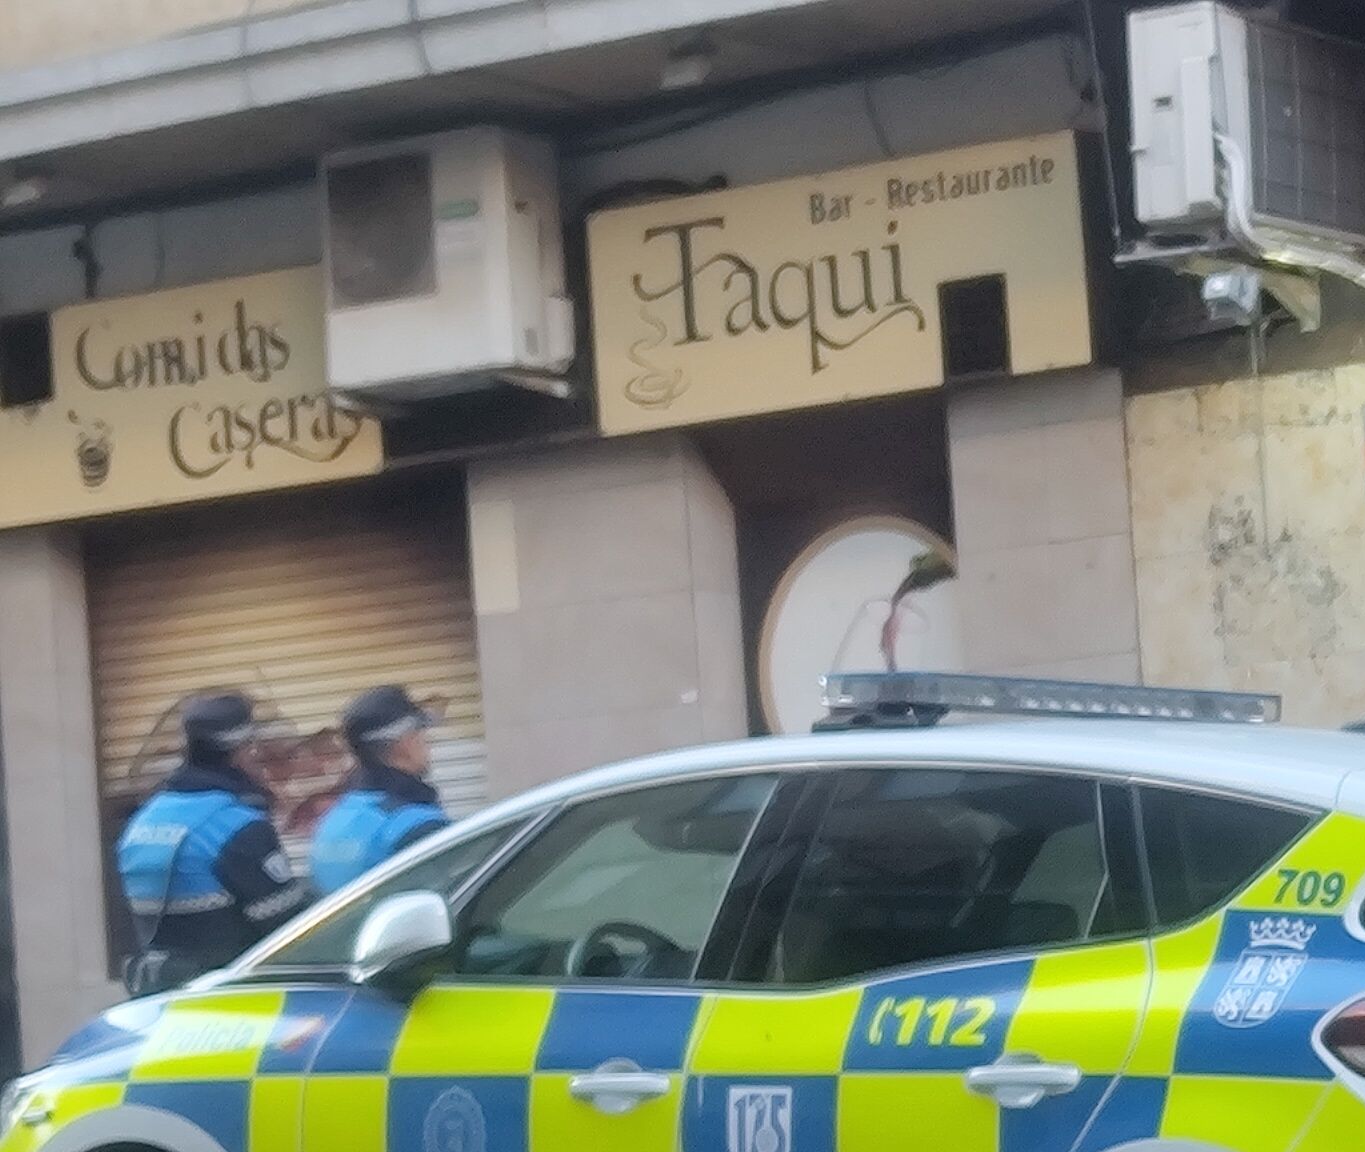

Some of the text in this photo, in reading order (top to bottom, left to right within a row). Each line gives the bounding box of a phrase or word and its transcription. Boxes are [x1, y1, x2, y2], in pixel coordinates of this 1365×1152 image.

[809, 190, 854, 225] Bar
[886, 153, 1056, 210] Restaurante
[632, 216, 926, 375] Taqui
[1273, 868, 1346, 908] 709
[892, 997, 997, 1047] 112
